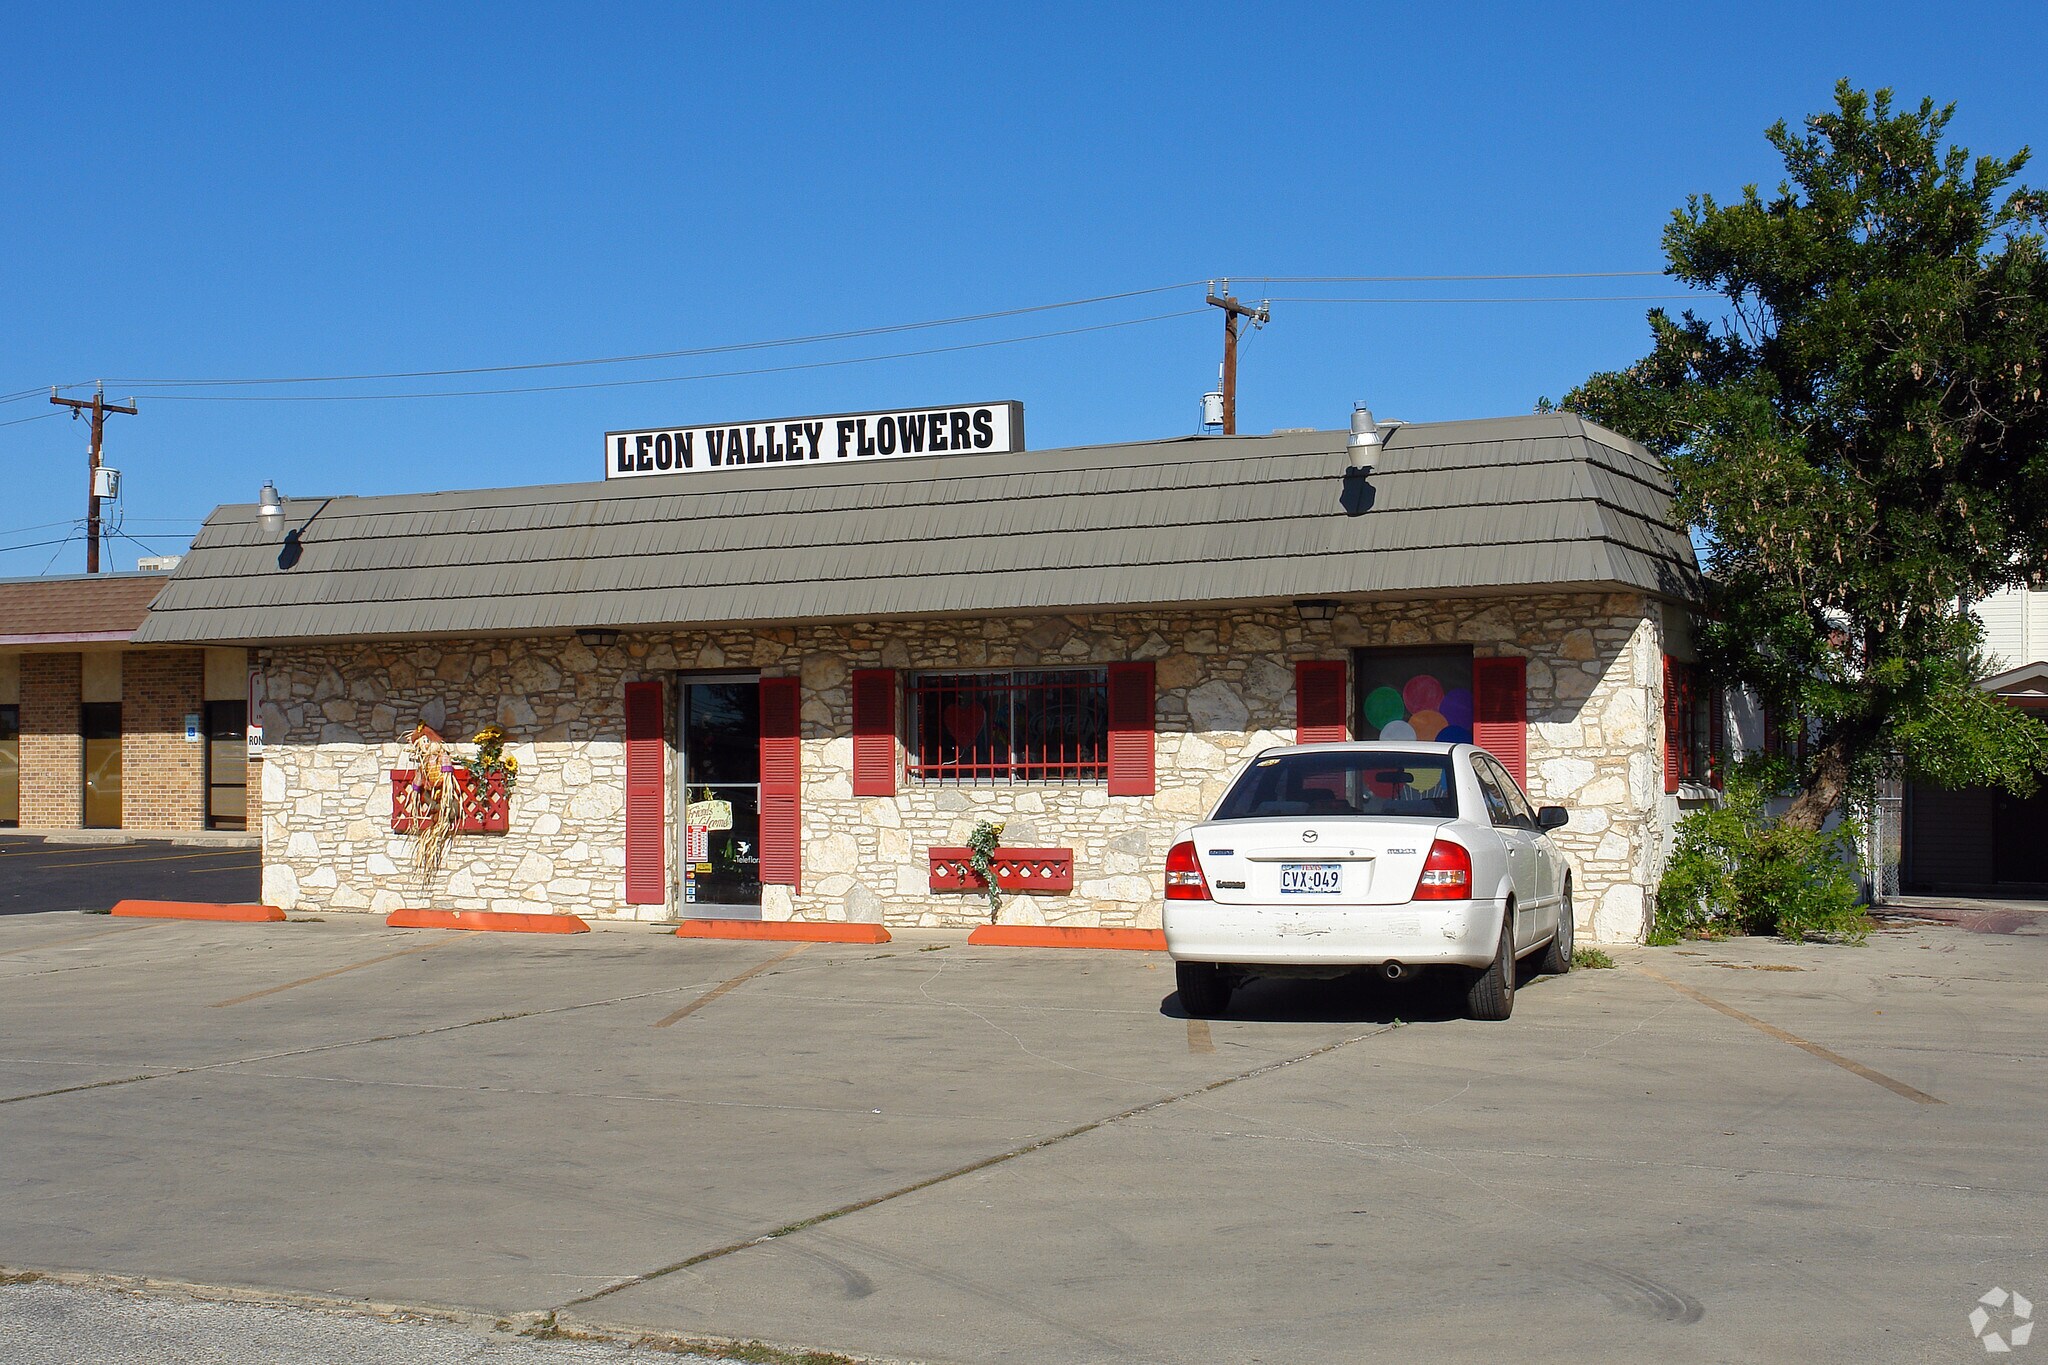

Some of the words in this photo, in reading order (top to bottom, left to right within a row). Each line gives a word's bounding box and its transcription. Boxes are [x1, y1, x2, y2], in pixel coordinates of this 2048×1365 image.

[617, 432, 693, 472] LEON
[706, 422, 823, 466] VALLEY
[836, 409, 993, 458] FLOWERS
[735, 855, 761, 864] Teleflor
